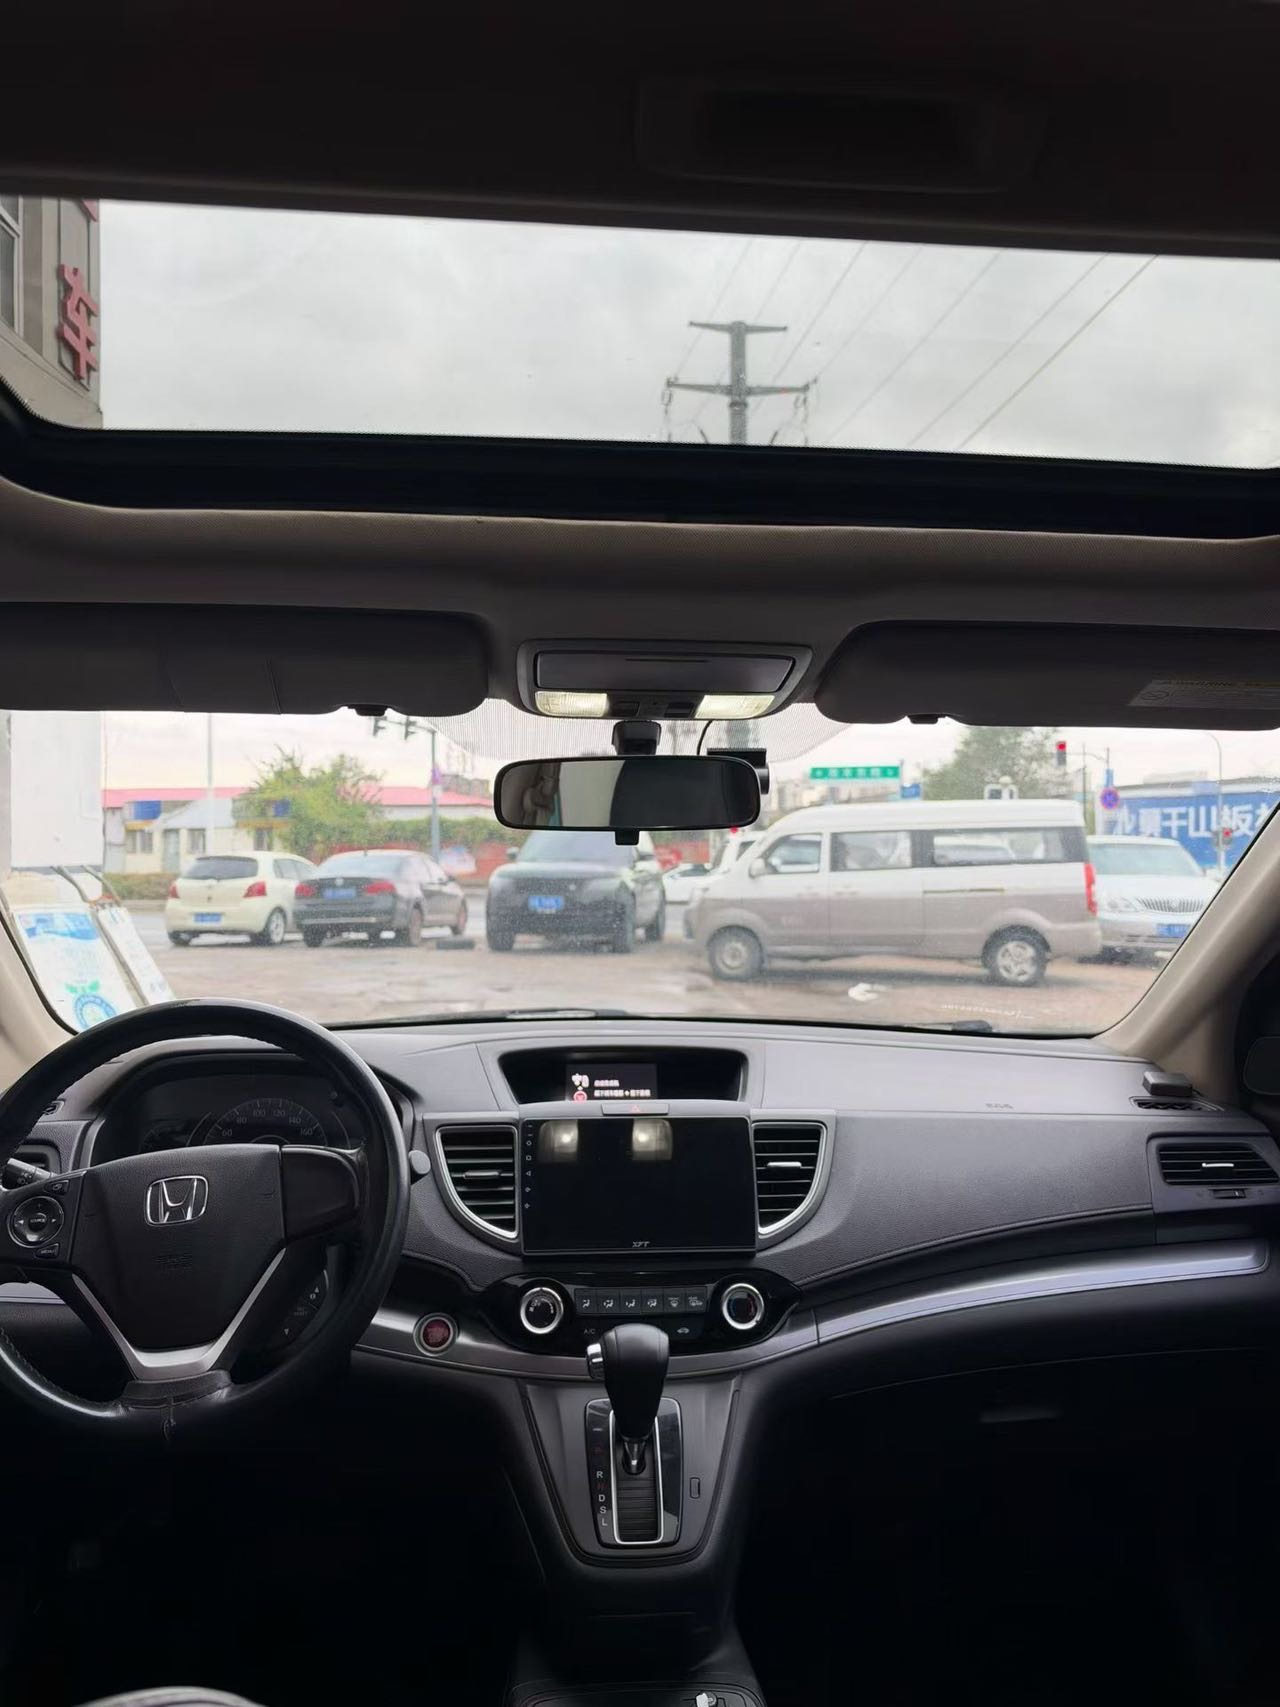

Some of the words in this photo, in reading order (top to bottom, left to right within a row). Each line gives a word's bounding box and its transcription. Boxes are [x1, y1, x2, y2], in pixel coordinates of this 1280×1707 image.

[596, 1471, 604, 1479] R
[598, 1494, 606, 1502] D
[599, 1506, 607, 1514] S
[601, 1518, 608, 1526] L
